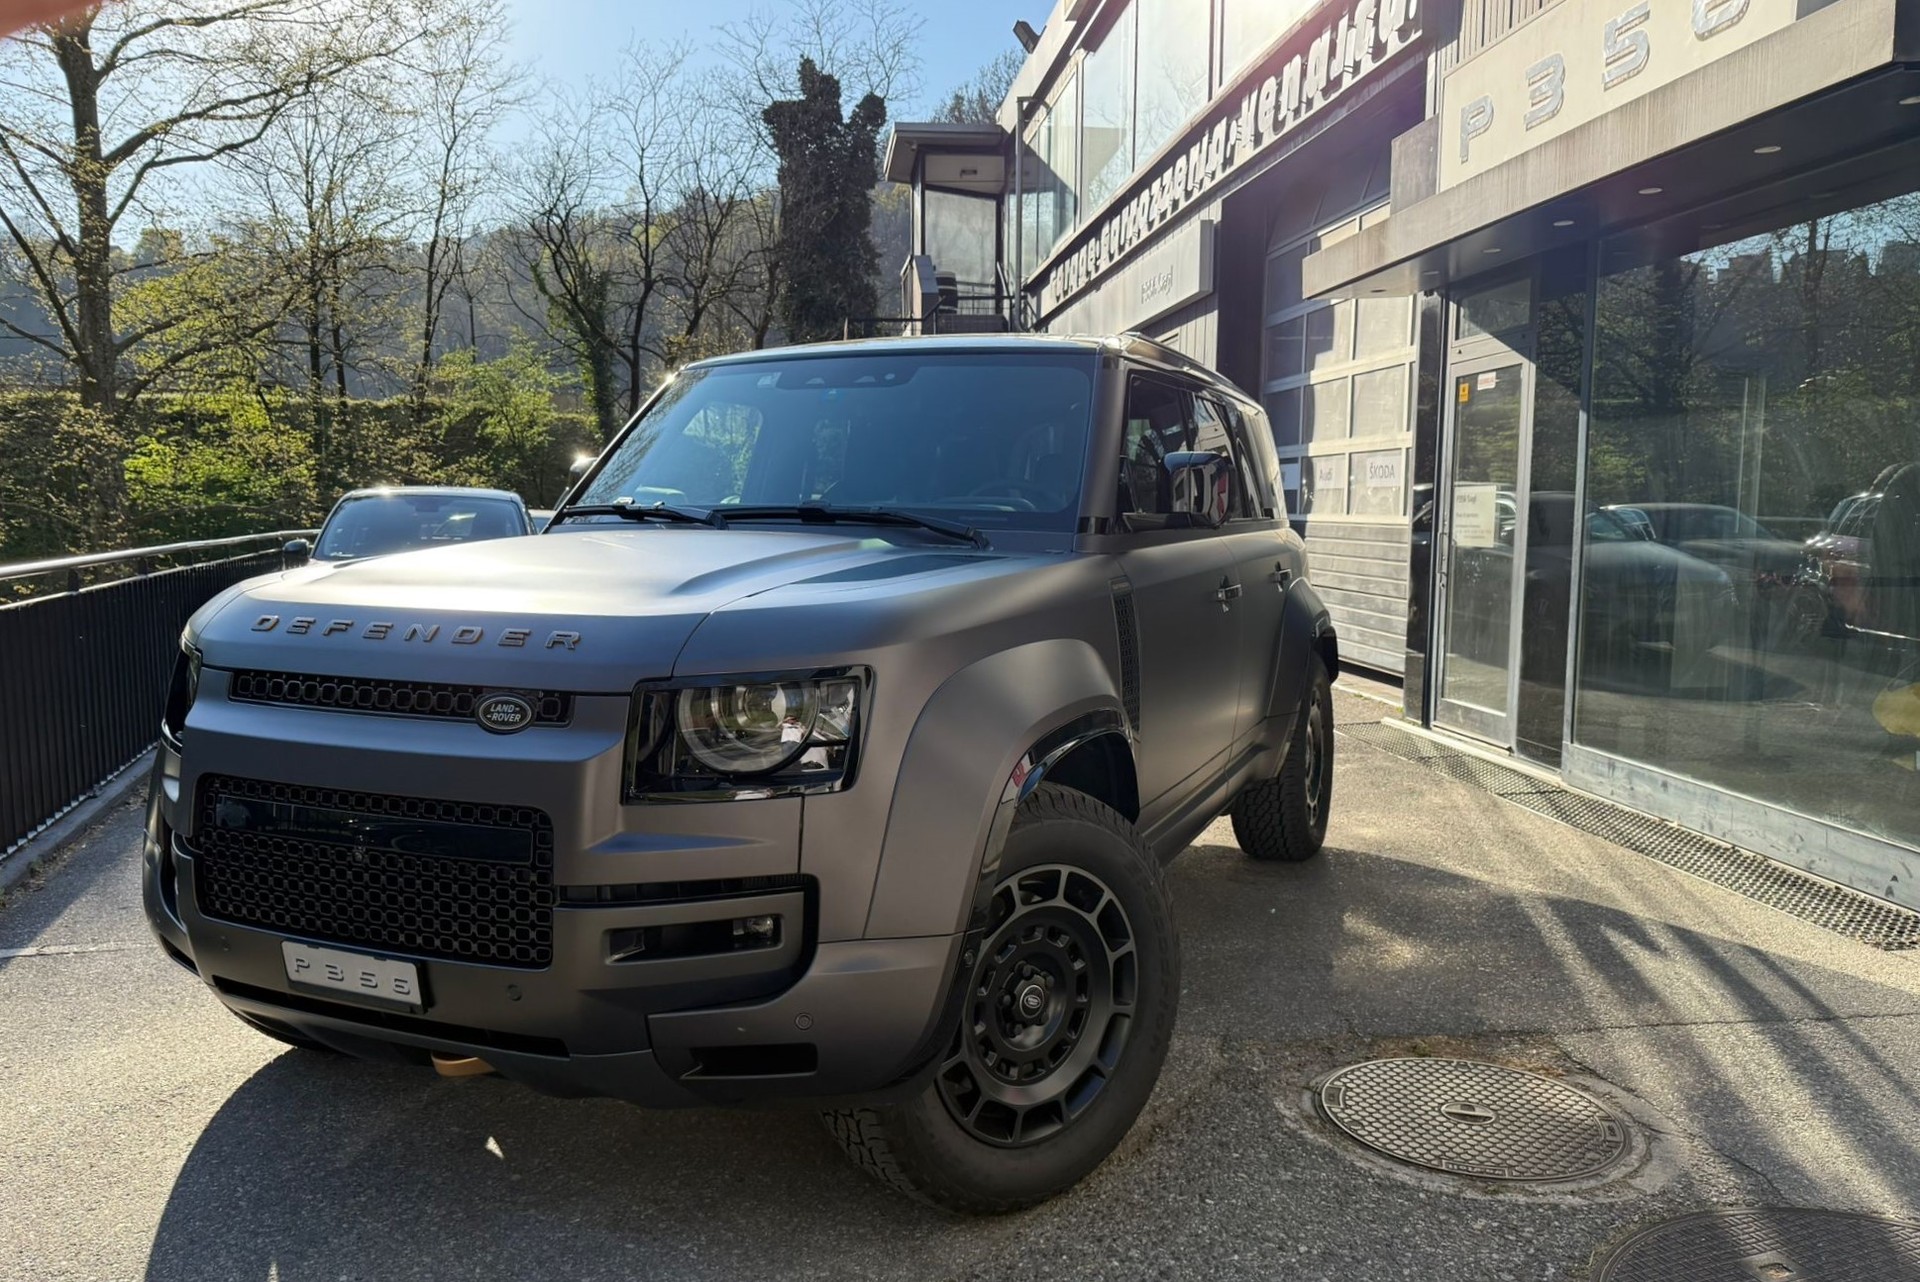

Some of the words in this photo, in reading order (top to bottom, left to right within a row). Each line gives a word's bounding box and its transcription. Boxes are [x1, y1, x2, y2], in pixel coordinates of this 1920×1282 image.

[1369, 463, 1396, 480] ŠKODA
[250, 614, 581, 650] DEFENDER
[294, 957, 411, 996] P356
